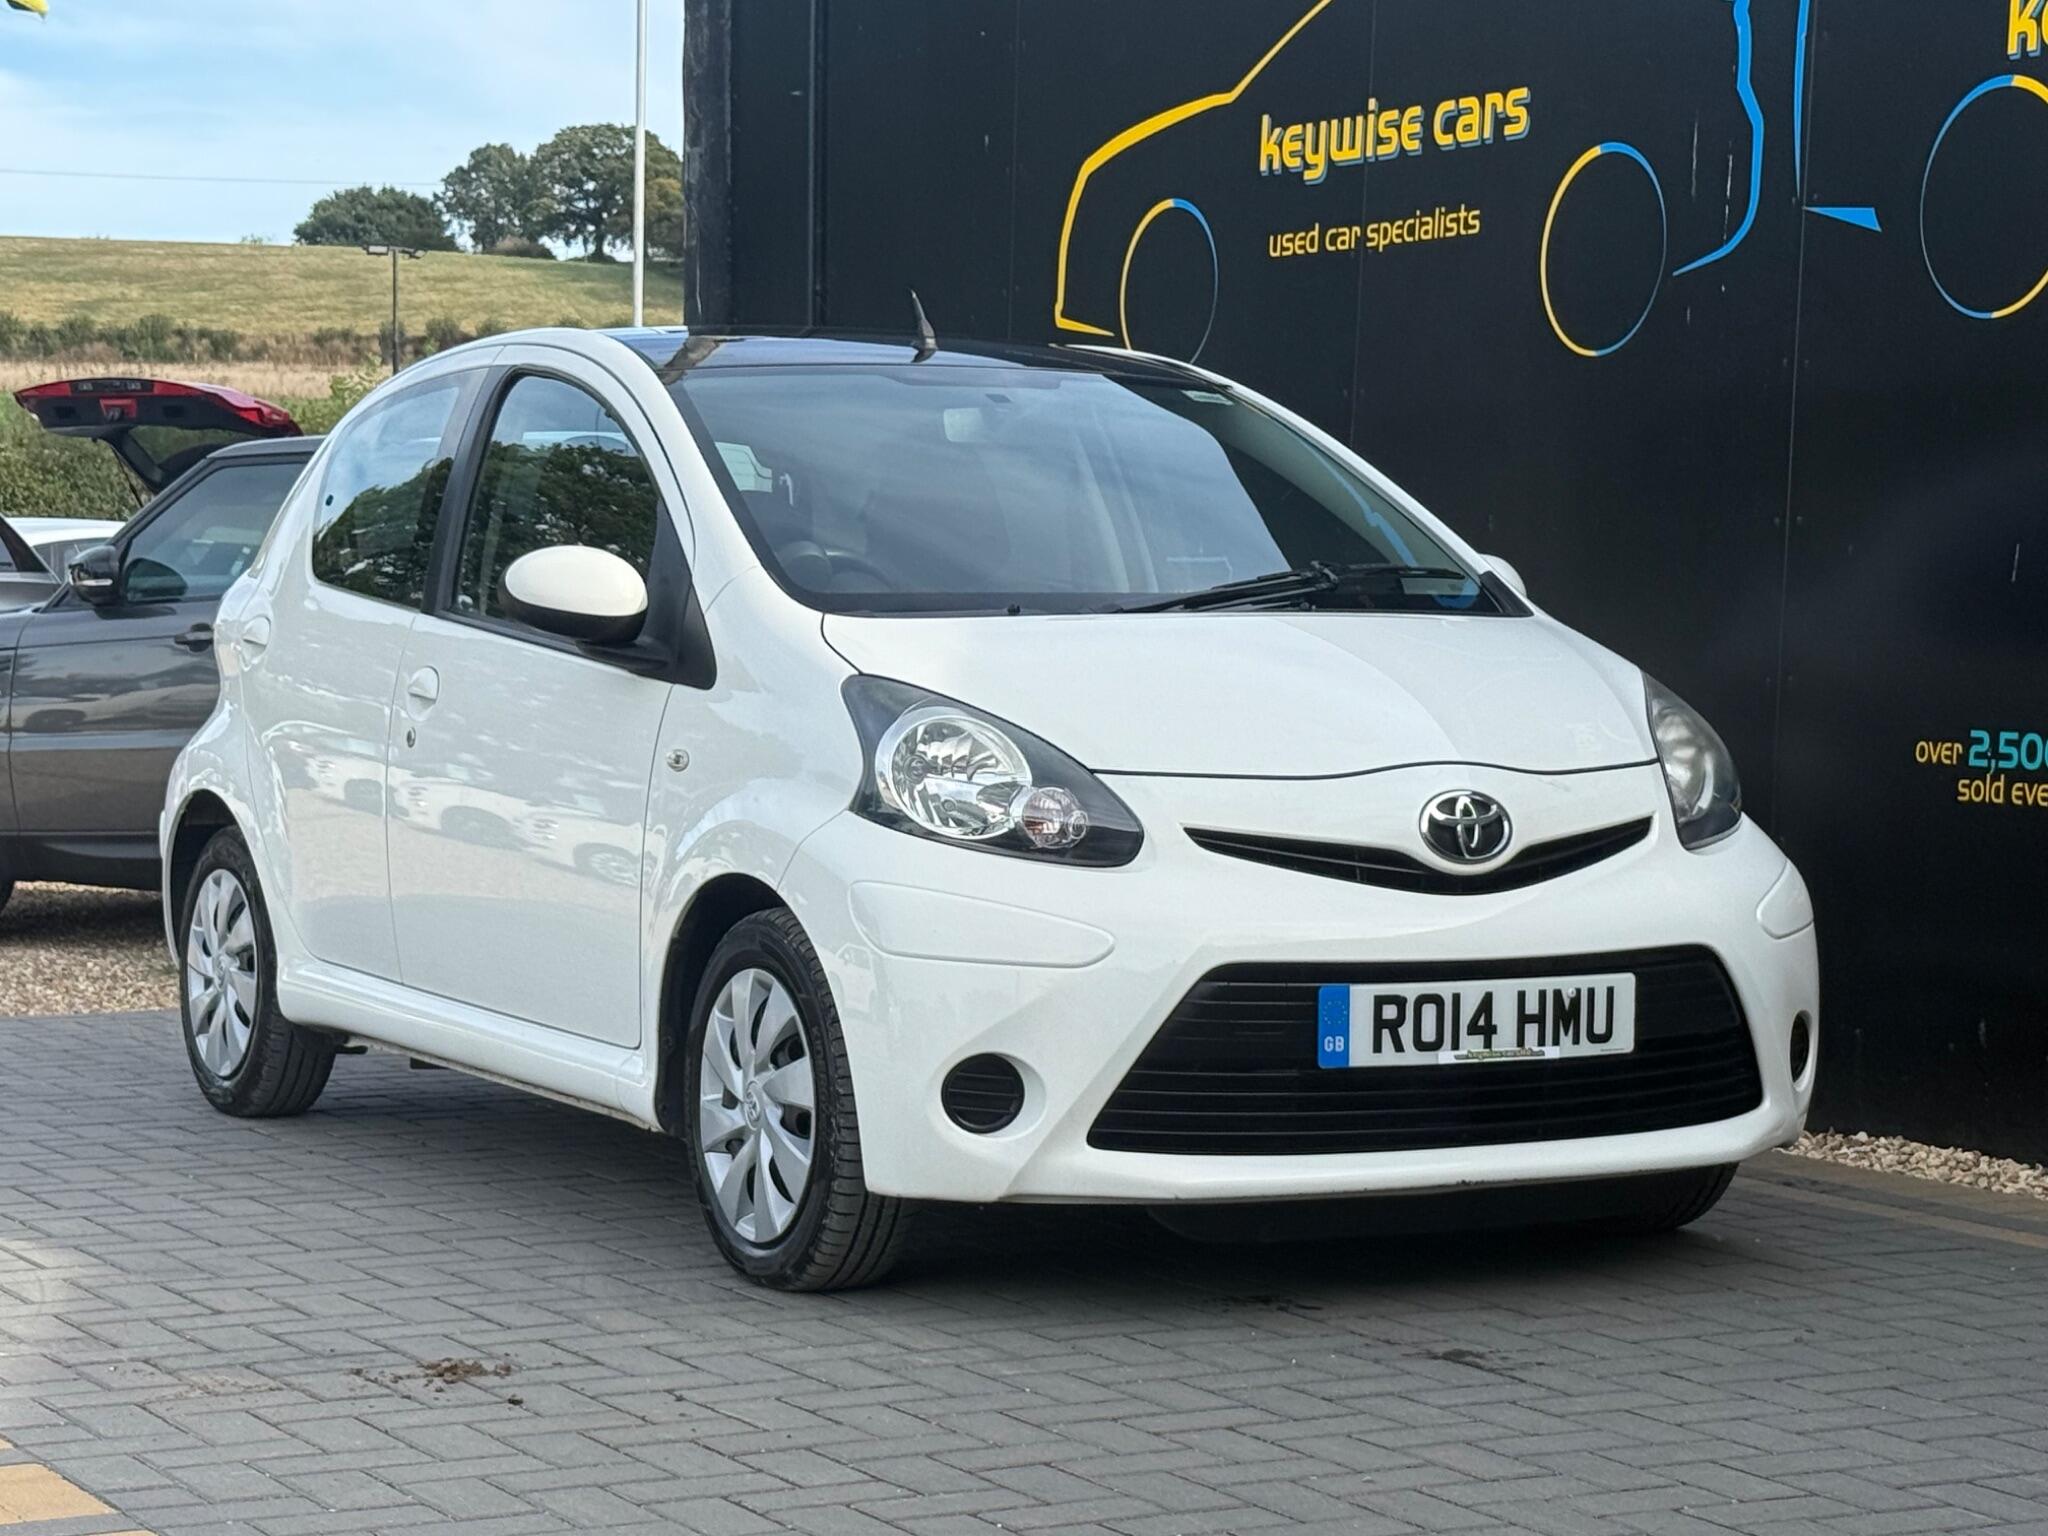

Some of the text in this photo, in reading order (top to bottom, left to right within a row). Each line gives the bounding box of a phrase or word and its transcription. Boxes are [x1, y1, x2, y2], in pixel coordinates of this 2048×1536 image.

[1259, 87, 1531, 185] keywise cars
[1269, 203, 1481, 257] used car specialists
[1915, 729, 2048, 774] over 2,50
[1957, 773, 2005, 804] sold
[1323, 1035, 1345, 1052] GB
[1371, 986, 1615, 1053] RO14 HMU
